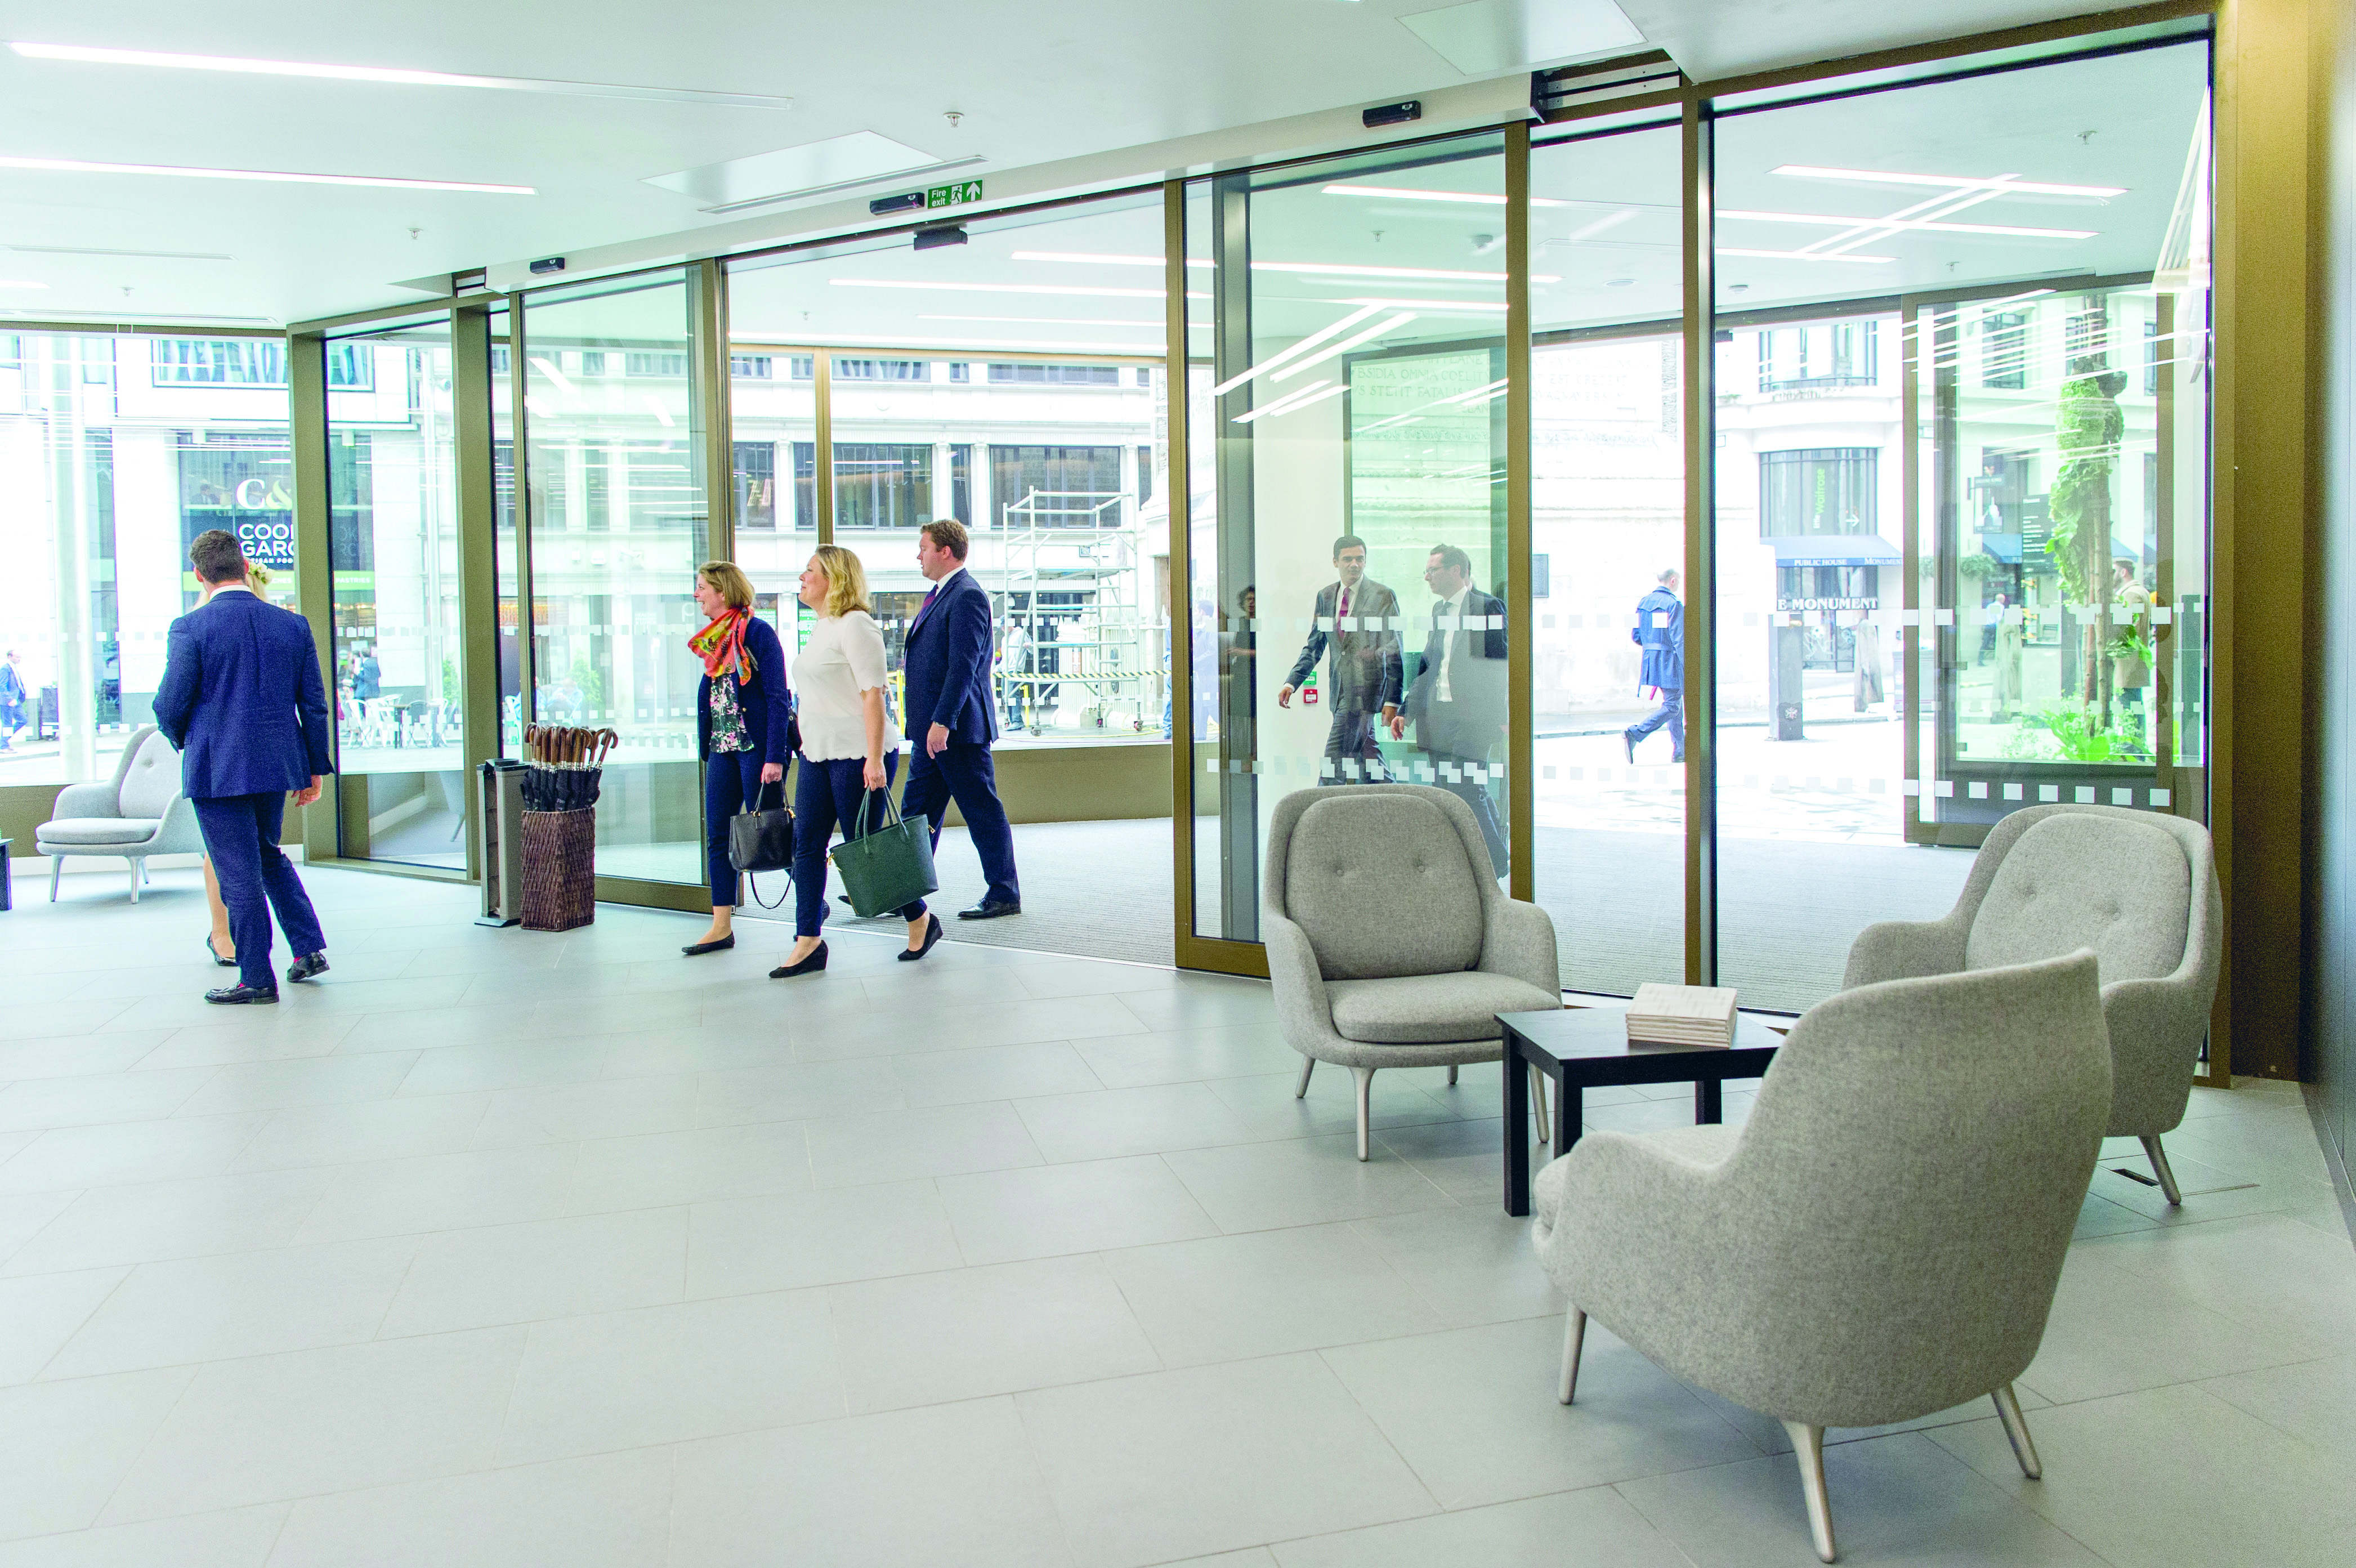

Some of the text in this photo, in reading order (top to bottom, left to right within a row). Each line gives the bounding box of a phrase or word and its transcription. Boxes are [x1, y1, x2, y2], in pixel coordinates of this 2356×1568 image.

[932, 190, 946, 198] Fire
[932, 198, 946, 207] exit
[1814, 468, 1826, 515] waitrose
[239, 524, 293, 540] COO
[1792, 597, 1878, 610] MONUMENT
